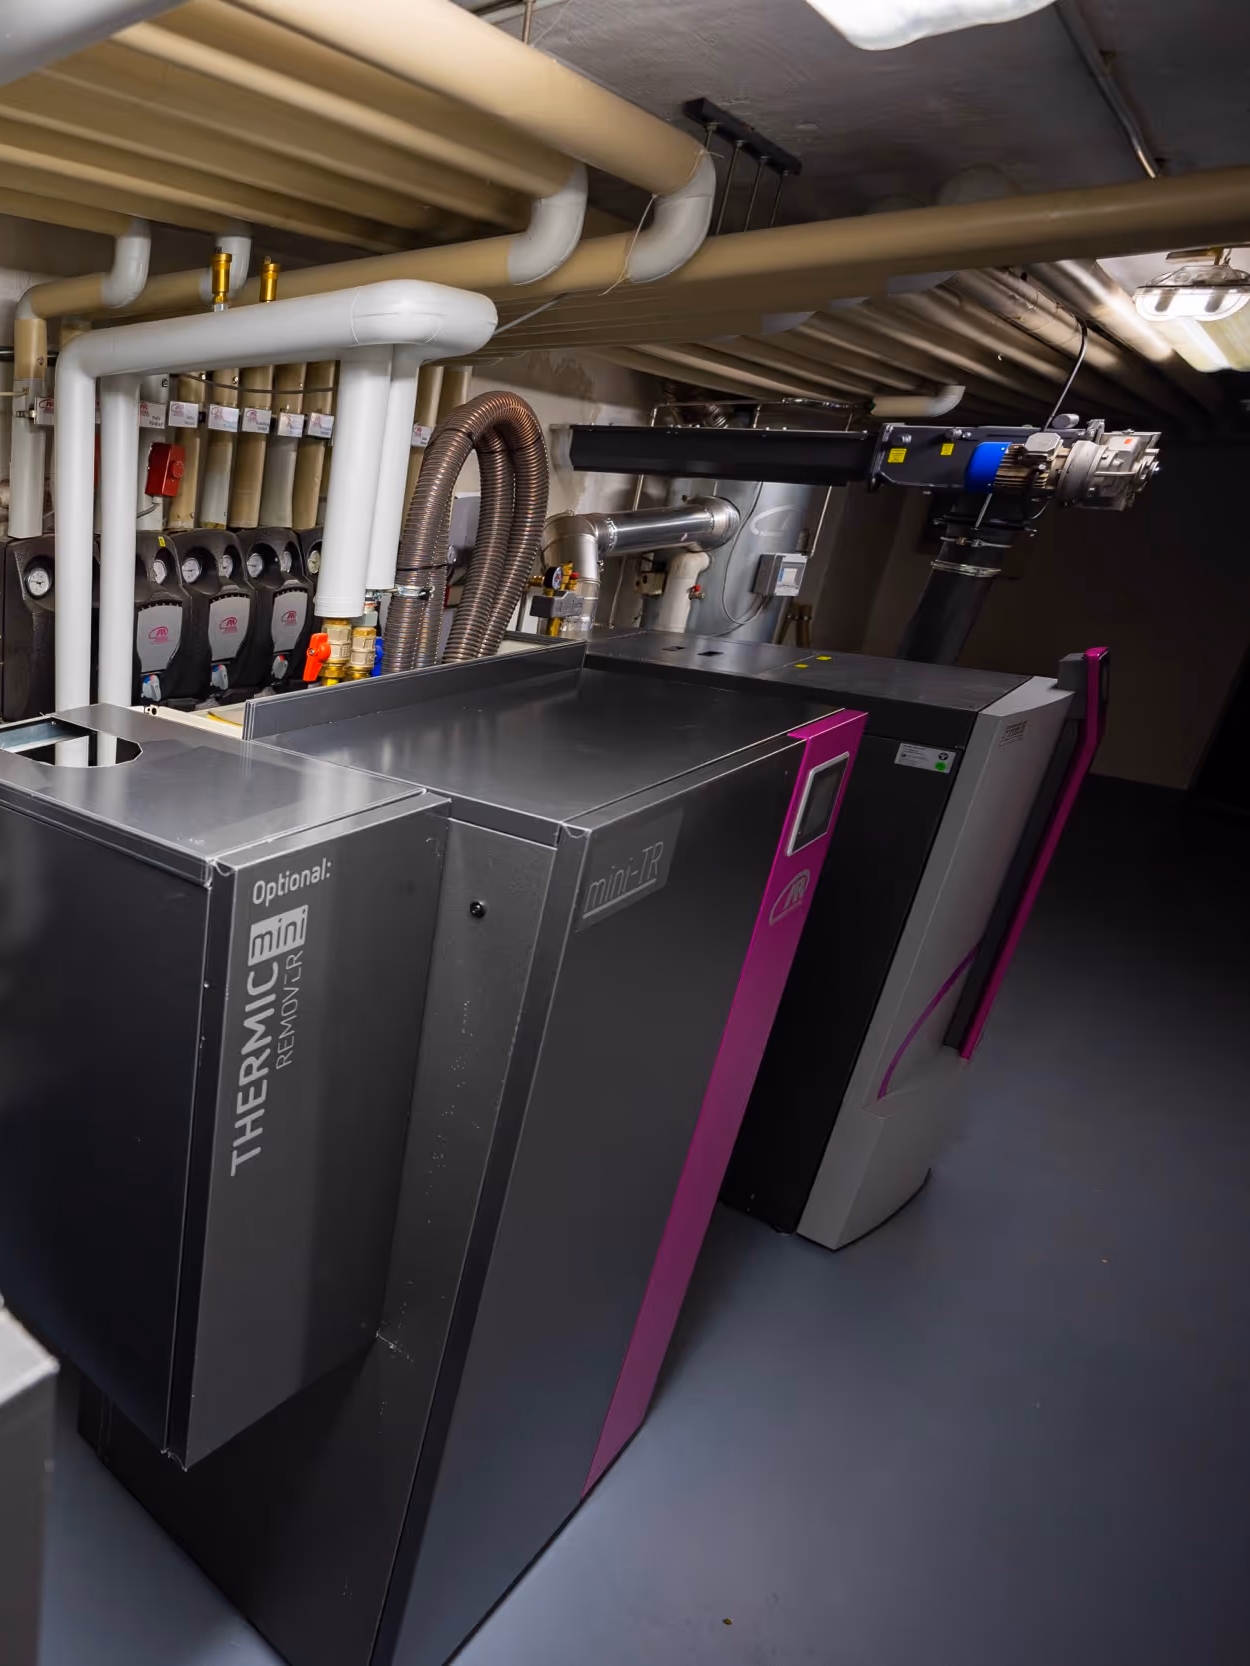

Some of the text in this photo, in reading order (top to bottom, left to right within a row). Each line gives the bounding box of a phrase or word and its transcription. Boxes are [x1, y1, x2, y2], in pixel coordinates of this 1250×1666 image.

[252, 858, 332, 907] Optional:
[583, 841, 664, 914] mini-TR
[251, 908, 307, 960] mini
[276, 950, 304, 1070] REMOVER
[230, 961, 278, 1177] THERMIC
